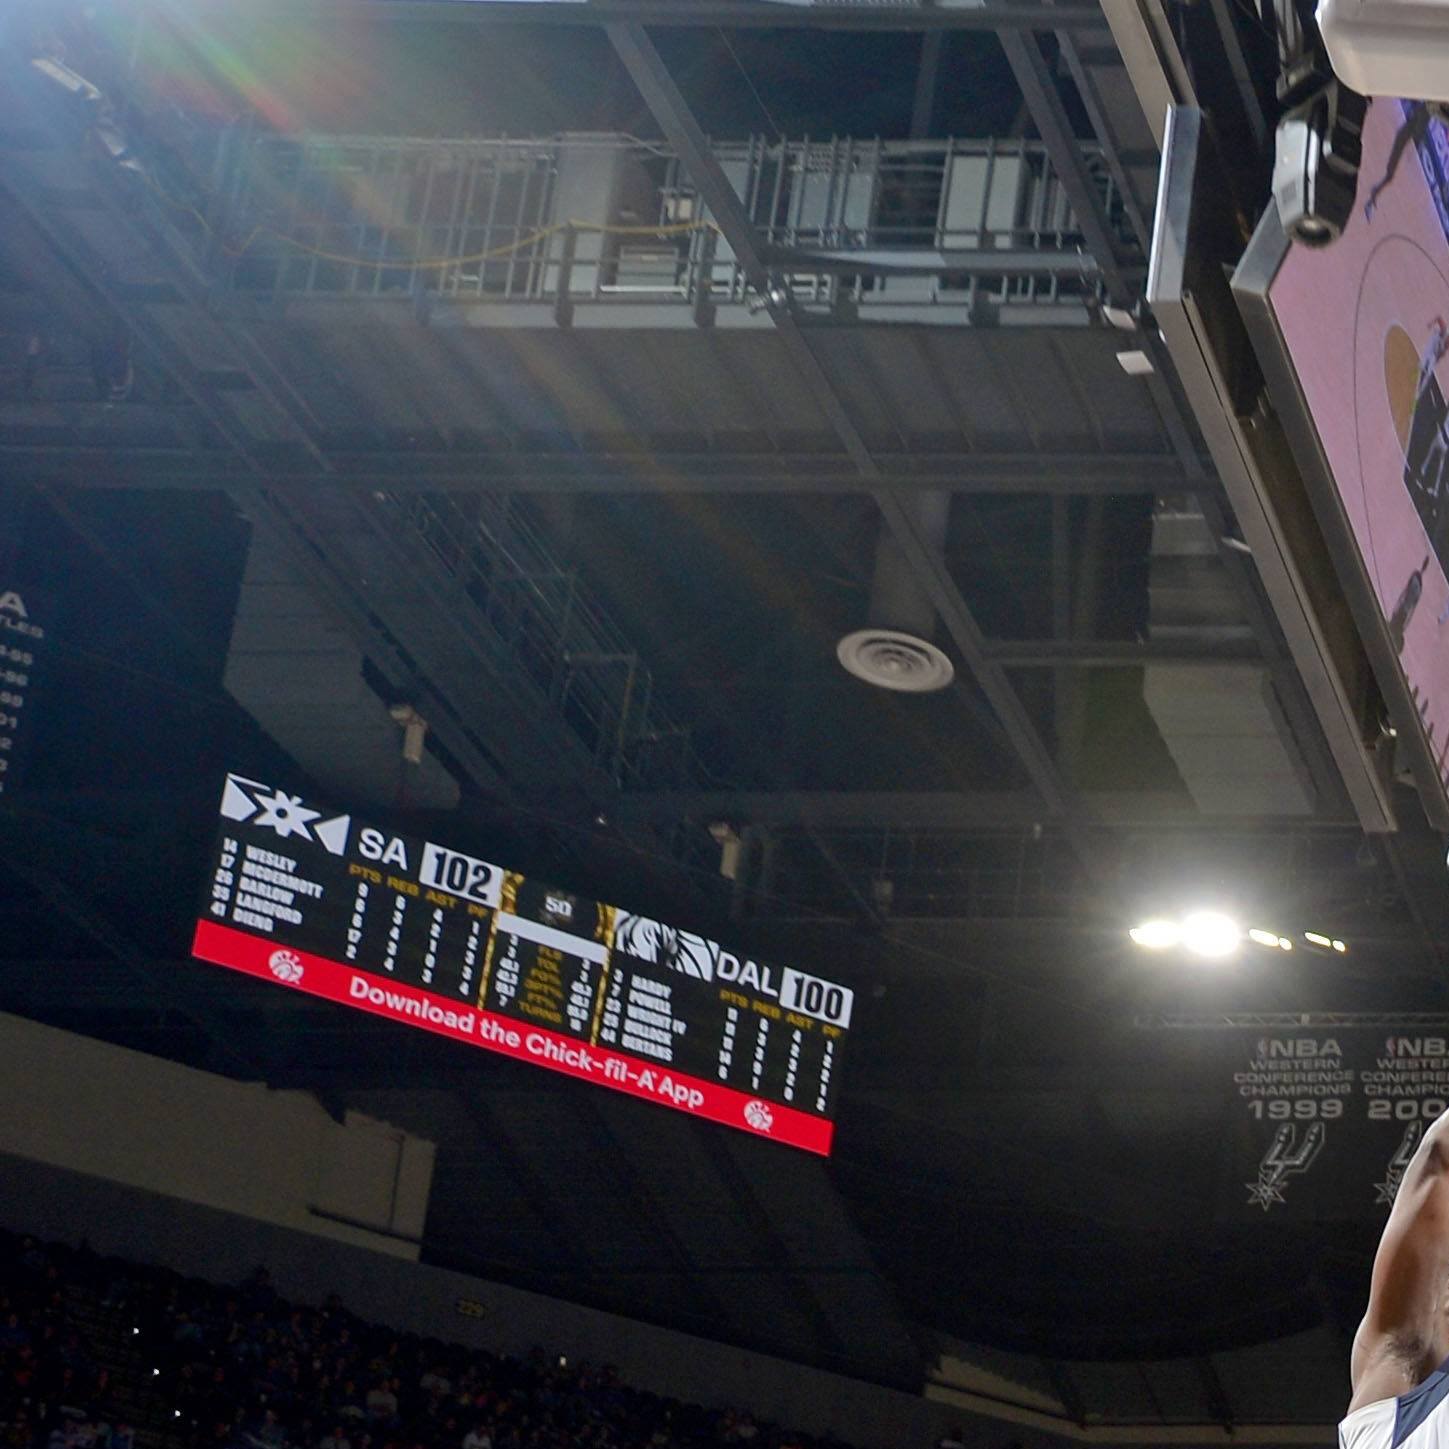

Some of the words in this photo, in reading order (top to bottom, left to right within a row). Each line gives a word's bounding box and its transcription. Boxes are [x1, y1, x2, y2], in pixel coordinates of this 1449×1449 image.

[357, 827, 409, 871] SA
[433, 851, 492, 900] 102
[715, 950, 779, 997] DAL
[792, 975, 844, 1021] 100
[349, 976, 473, 1030] Download
[482, 1020, 520, 1048] the
[658, 1074, 704, 1109] App
[1270, 1038, 1342, 1056] NBA
[1251, 1058, 1341, 1070] WESTERN
[1234, 1070, 1355, 1083] CONFERENCE
[1240, 1083, 1351, 1097] CHAMPIONS
[1248, 1100, 1344, 1120] 1999
